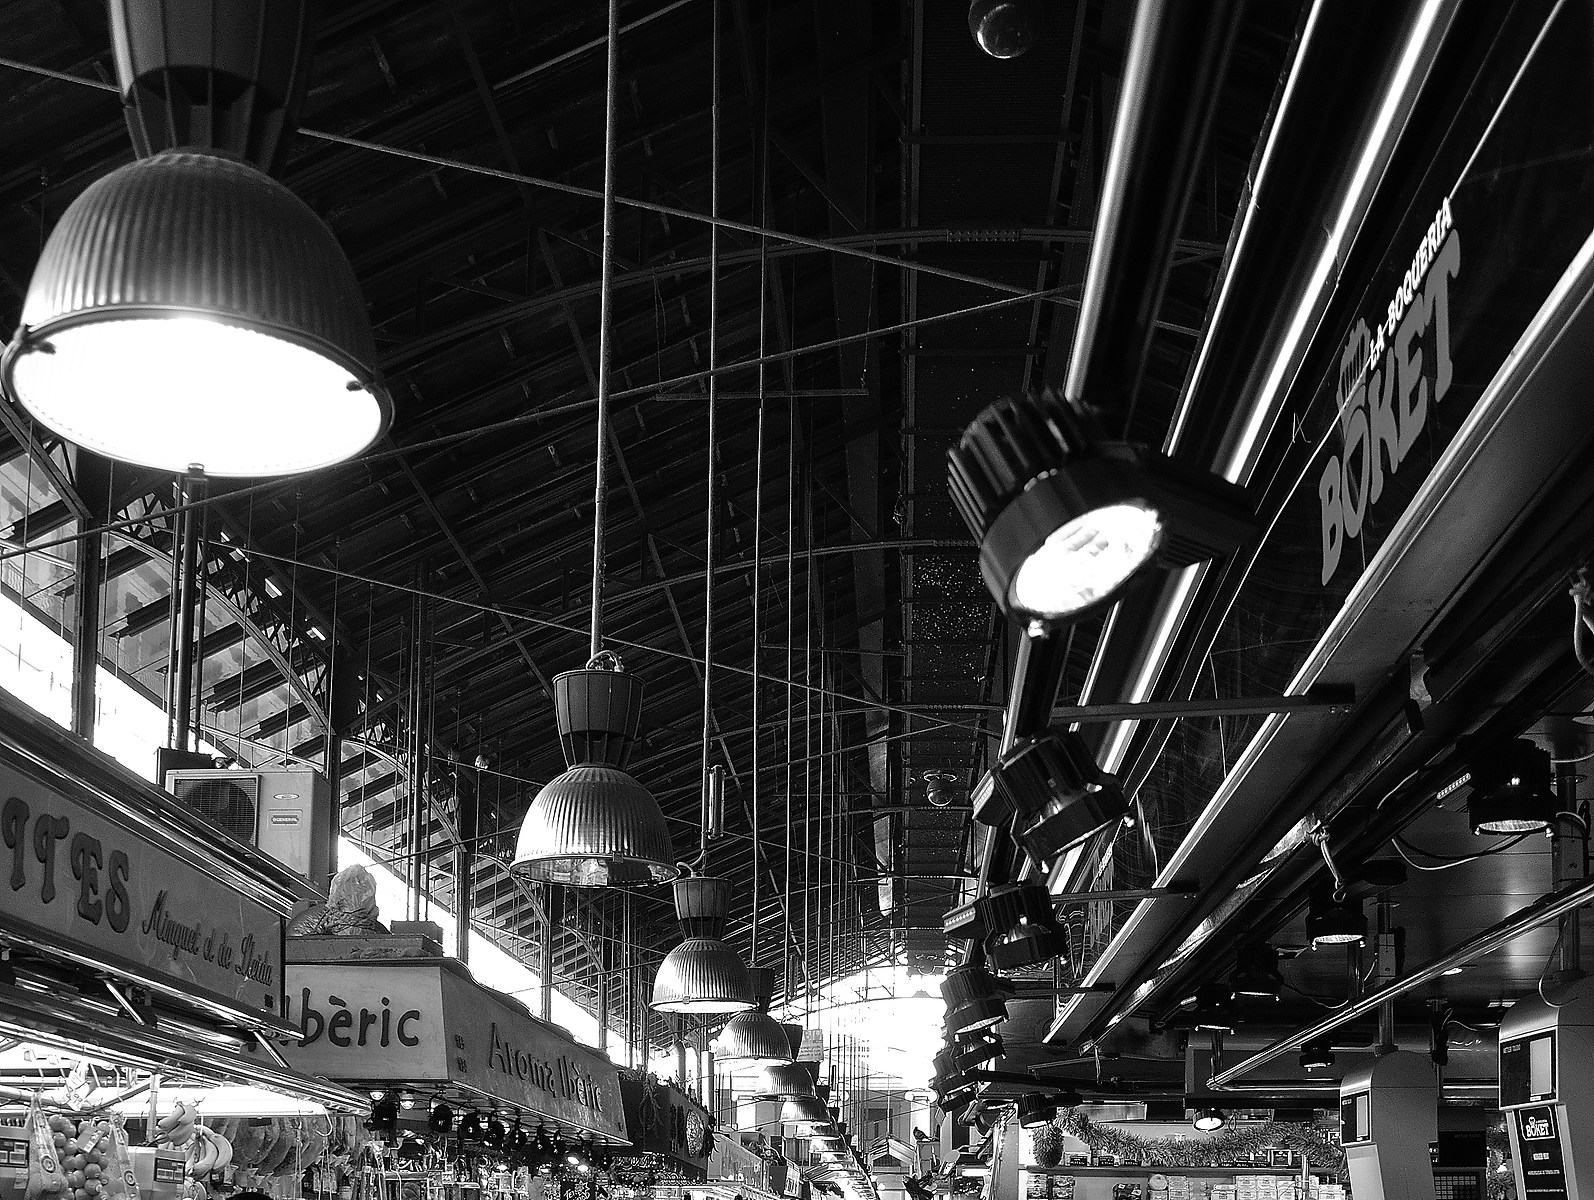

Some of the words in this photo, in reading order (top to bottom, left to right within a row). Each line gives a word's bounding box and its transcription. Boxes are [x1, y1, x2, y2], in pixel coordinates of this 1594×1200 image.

[1319, 229, 1460, 587] BOKET
[1369, 324, 1384, 371] LA
[1388, 197, 1452, 337] BOQUERIA
